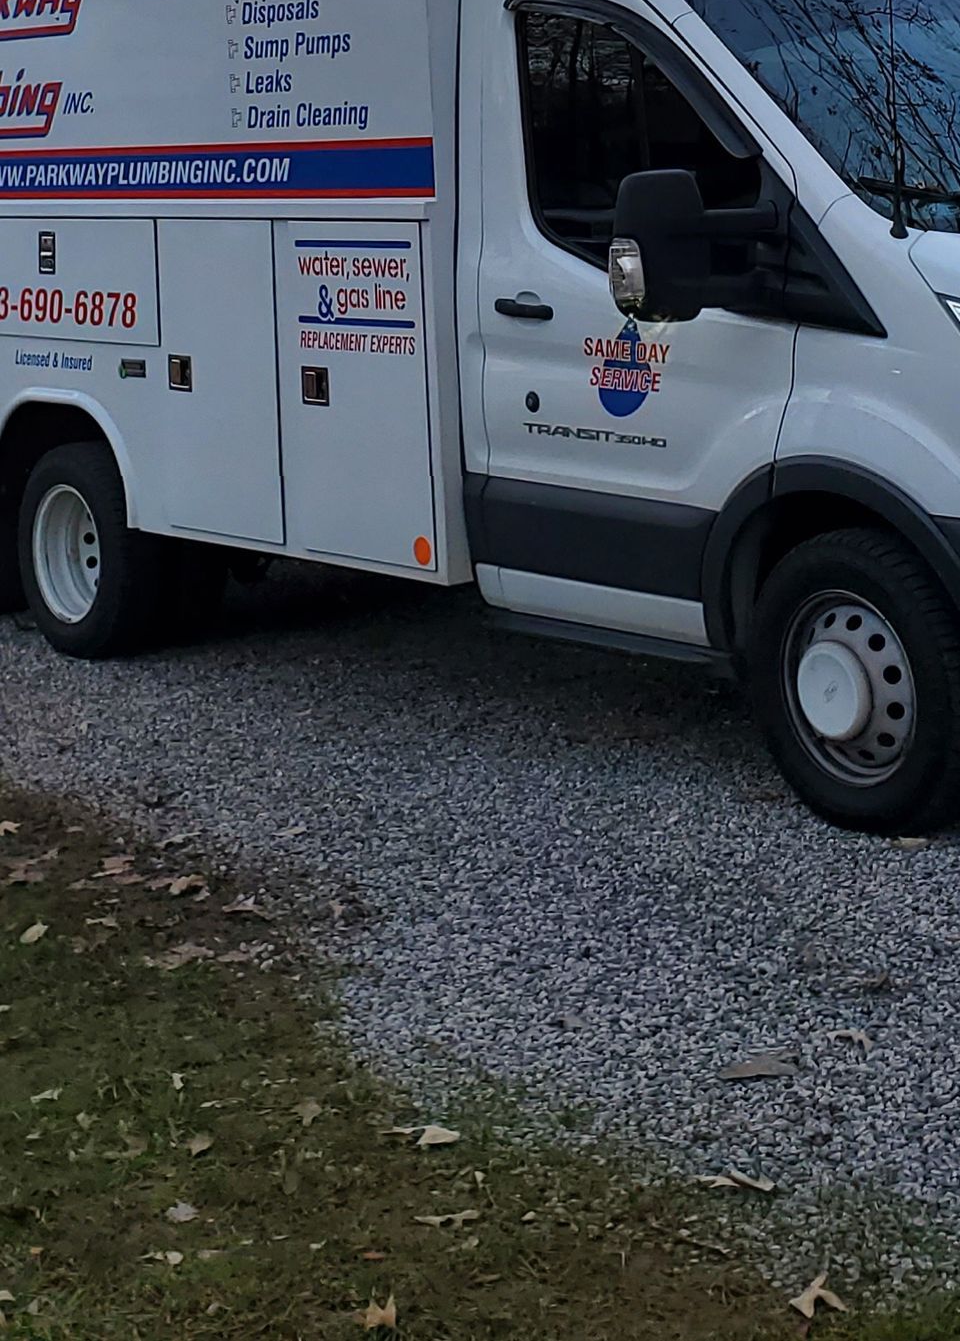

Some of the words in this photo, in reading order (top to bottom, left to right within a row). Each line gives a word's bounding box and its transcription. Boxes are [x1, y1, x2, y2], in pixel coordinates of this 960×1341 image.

[244, 36, 289, 62] Sump
[295, 32, 351, 59] Pumps
[245, 69, 292, 94] Leaks
[63, 91, 95, 114] INC.
[247, 104, 290, 128] Drain
[296, 101, 369, 130] Cleaning
[298, 250, 350, 280] water,
[352, 257, 410, 282] sewer,
[0, 286, 137, 328] 3-690-6878
[318, 284, 335, 319] &
[336, 287, 370, 315] gas
[374, 283, 406, 310] line
[300, 330, 368, 352] REPLACEMENT
[370, 335, 415, 356] EXPERTS
[583, 337, 631, 360] SAME
[636, 341, 670, 364] DAY
[15, 349, 51, 368] Licensed
[52, 352, 58, 368] &
[61, 352, 93, 371] Insured
[590, 366, 662, 393] SERVICE
[523, 422, 615, 442] TRANSIT
